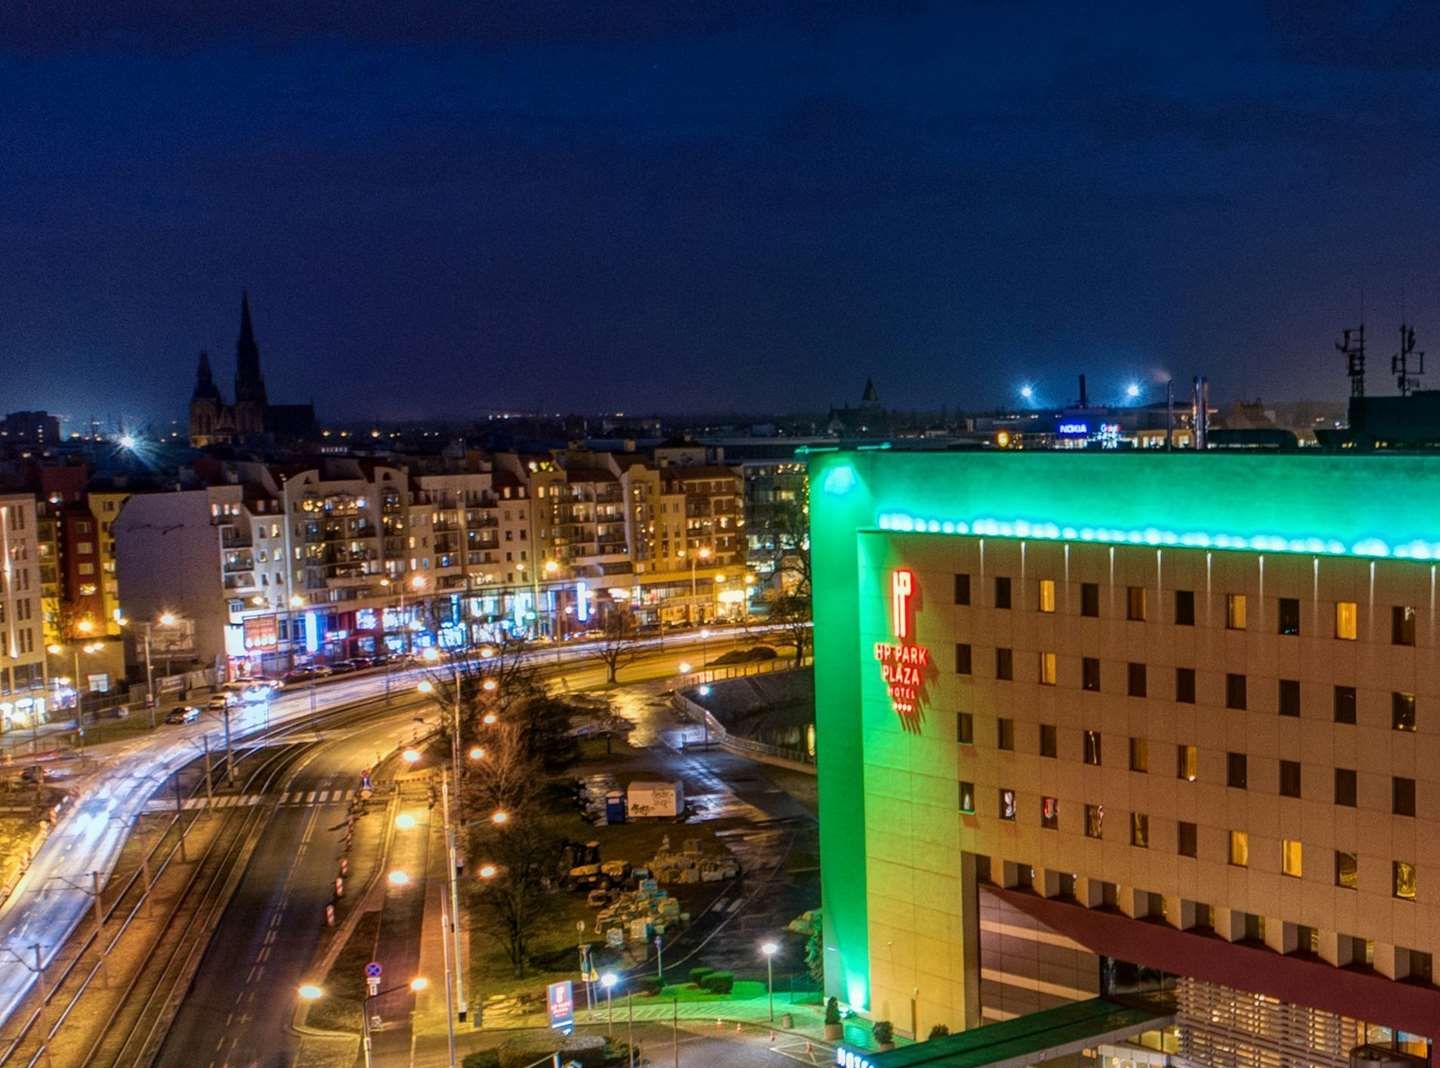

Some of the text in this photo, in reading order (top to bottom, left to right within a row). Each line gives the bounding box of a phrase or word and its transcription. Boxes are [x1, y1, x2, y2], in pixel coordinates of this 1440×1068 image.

[875, 643, 928, 665] HP PARK
[882, 664, 920, 686] PLAZA
[888, 687, 916, 699] HOTEL
